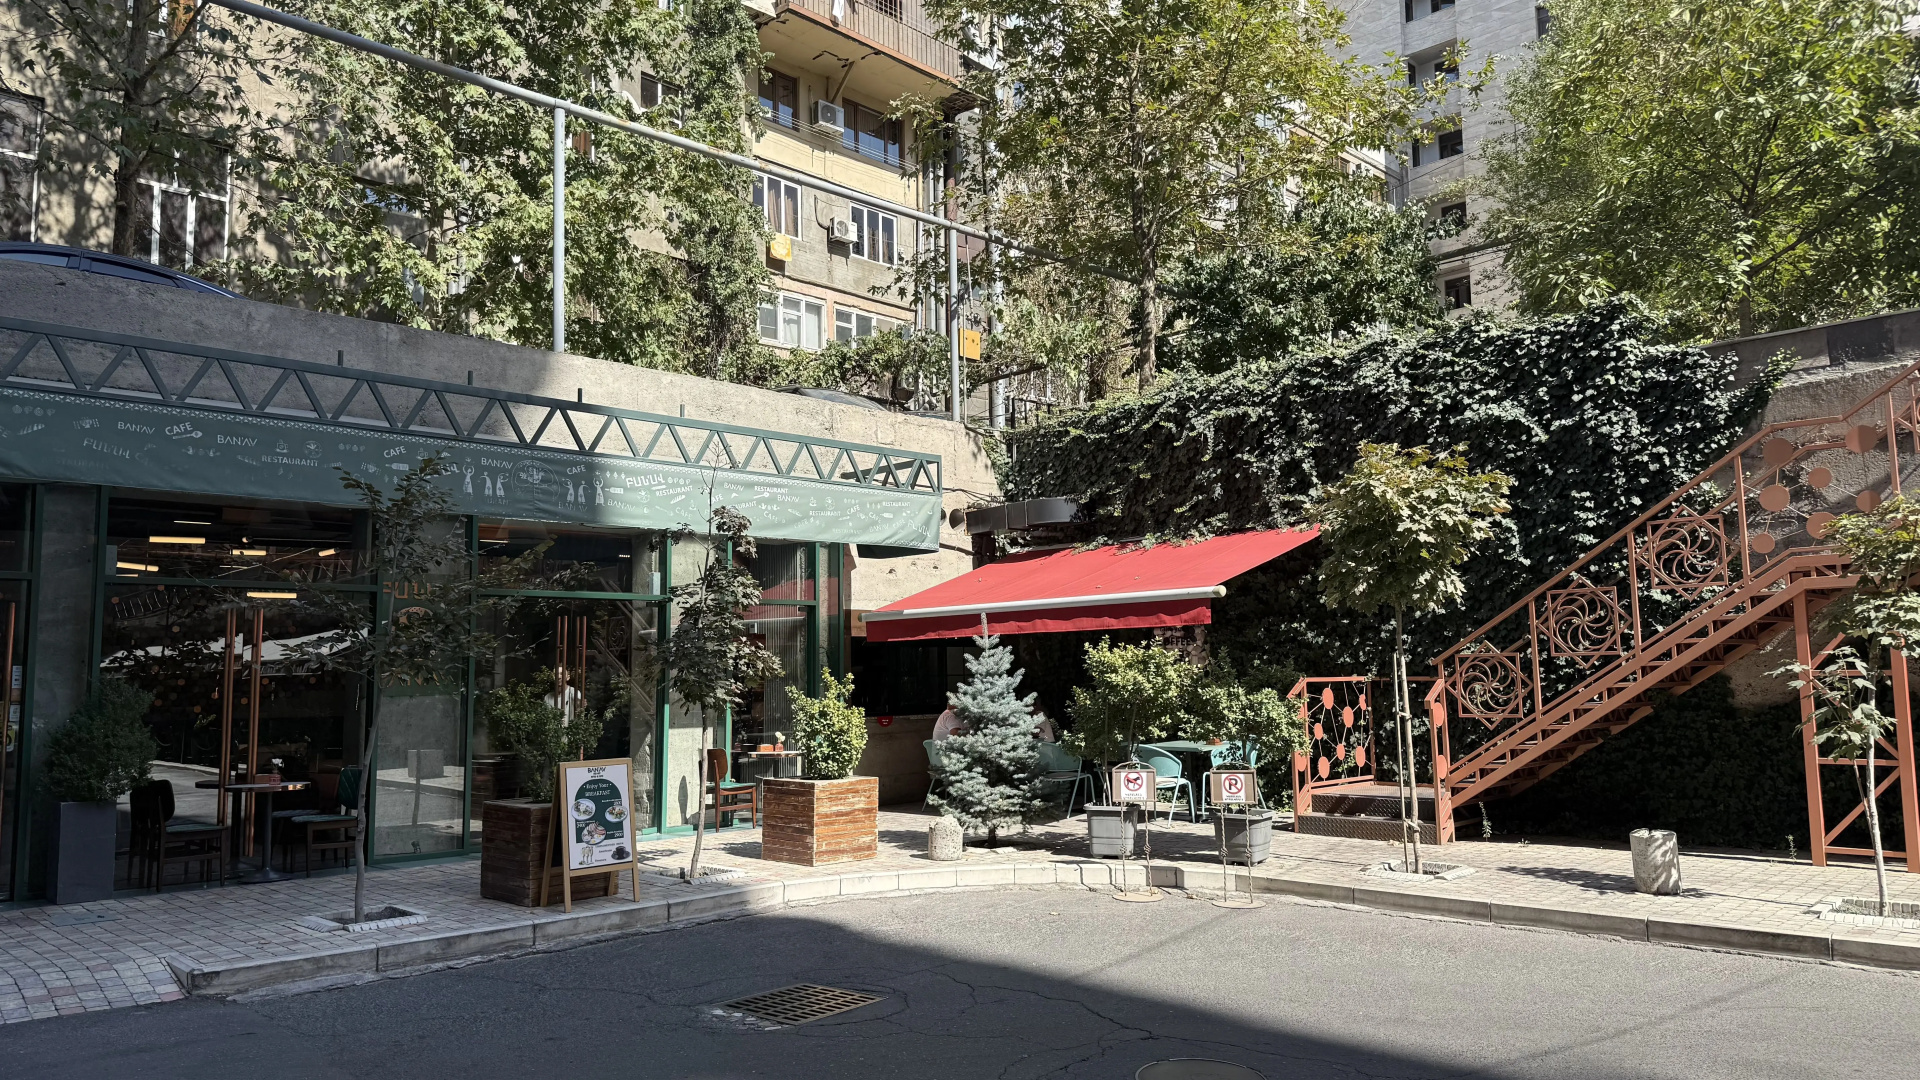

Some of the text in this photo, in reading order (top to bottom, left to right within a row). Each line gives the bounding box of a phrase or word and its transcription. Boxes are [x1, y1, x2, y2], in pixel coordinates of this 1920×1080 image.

[117, 421, 156, 435] BAN'AV
[164, 421, 194, 436] CAFE
[217, 434, 258, 447] BAN'AV
[383, 445, 407, 459] CAFE
[261, 454, 319, 468] RESTAURANT
[480, 457, 514, 469] BAN'AV
[566, 464, 587, 476] CAFE
[655, 484, 693, 498] RESTAURANT
[754, 485, 789, 494] RESTAURANT
[675, 506, 693, 520] CAFE
[846, 504, 861, 515] CAFE
[764, 510, 778, 524] CAFE
[868, 511, 882, 524] CAFE
